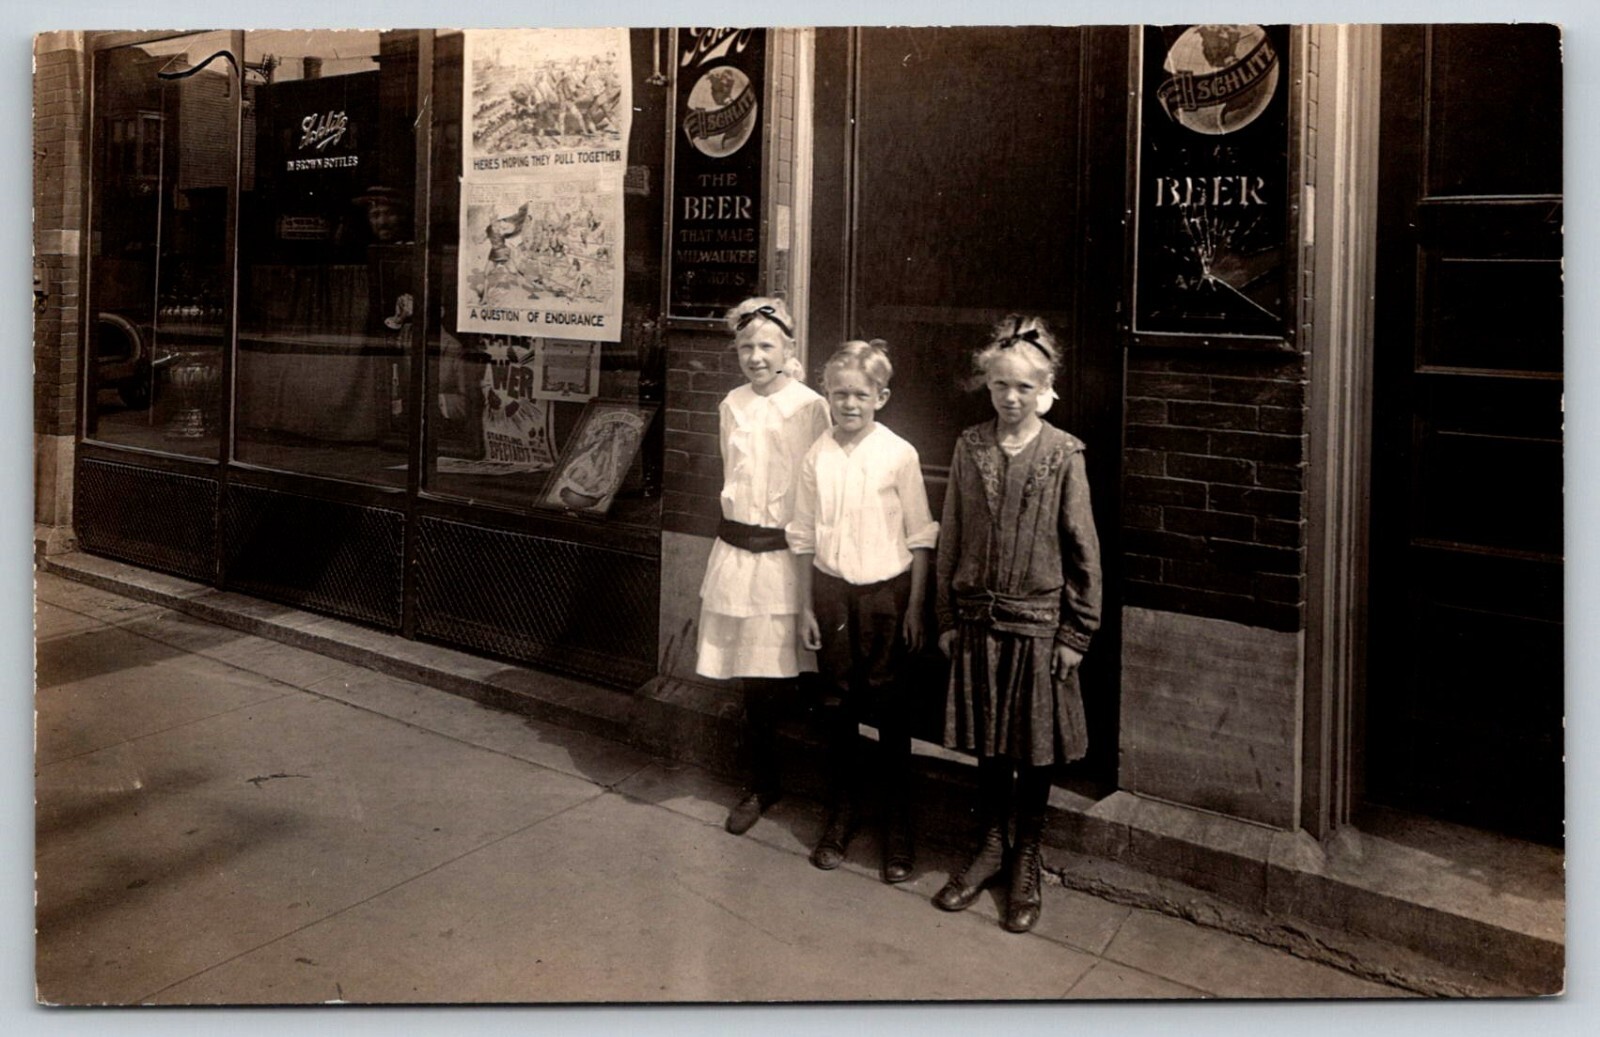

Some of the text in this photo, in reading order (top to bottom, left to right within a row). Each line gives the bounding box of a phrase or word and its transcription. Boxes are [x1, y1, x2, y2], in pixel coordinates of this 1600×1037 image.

[1196, 46, 1276, 100] SCHLITZ
[299, 110, 348, 151] Schlitz
[287, 156, 358, 171] IN BROWN BOTTLES
[502, 157, 529, 169] HOPING
[532, 155, 550, 167] THEY
[555, 153, 575, 165] PULL
[578, 150, 621, 163] TOGETHER
[699, 173, 738, 187] THE
[1155, 175, 1267, 207] BEER
[683, 195, 752, 219] BEER
[680, 228, 714, 242] THAT
[470, 309, 604, 327] A QUESTION OF ENDURANCE
